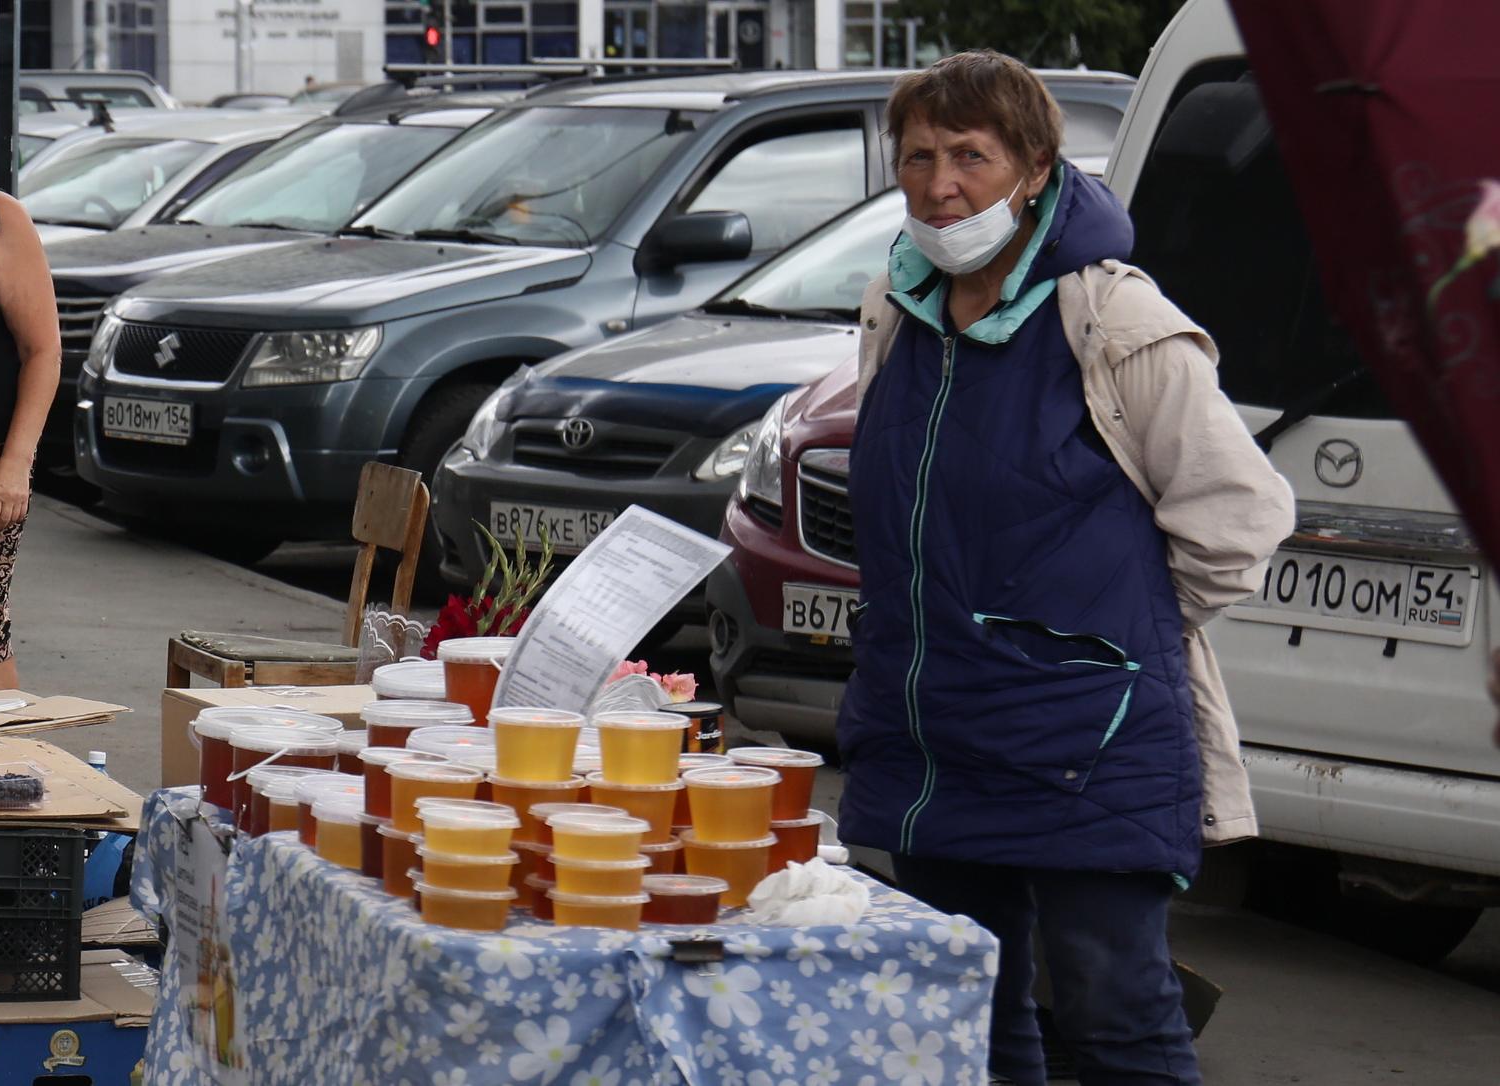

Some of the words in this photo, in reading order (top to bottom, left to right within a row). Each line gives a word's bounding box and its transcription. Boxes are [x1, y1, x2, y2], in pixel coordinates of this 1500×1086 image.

[164, 404, 189, 427] 154
[1412, 571, 1455, 609] 54
[1408, 608, 1439, 624] RUS
